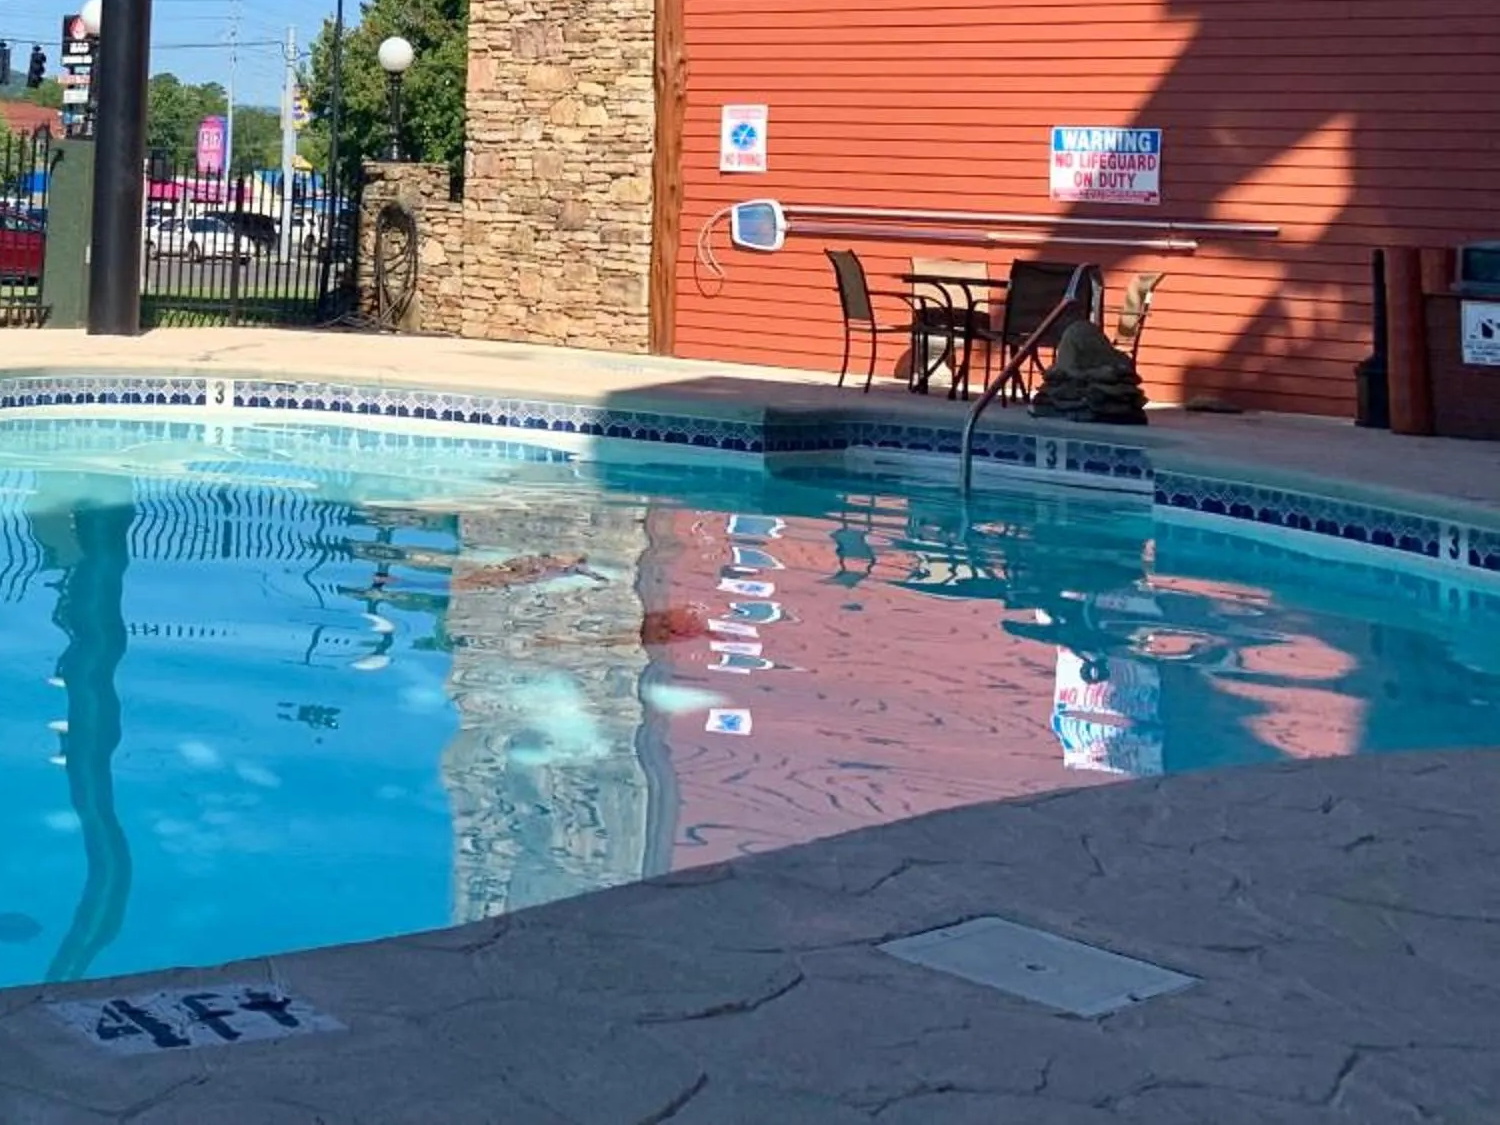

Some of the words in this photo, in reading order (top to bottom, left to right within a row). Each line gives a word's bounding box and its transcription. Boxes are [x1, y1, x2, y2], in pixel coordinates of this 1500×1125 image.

[1062, 129, 1152, 152] WARNING
[1056, 152, 1073, 169] NO
[1080, 152, 1157, 172] LIFEGUARD
[1073, 171, 1093, 188] ON
[1098, 172, 1137, 189] DUTY
[214, 380, 226, 404] 3
[1045, 439, 1058, 470] 3
[1448, 523, 1460, 560] 3
